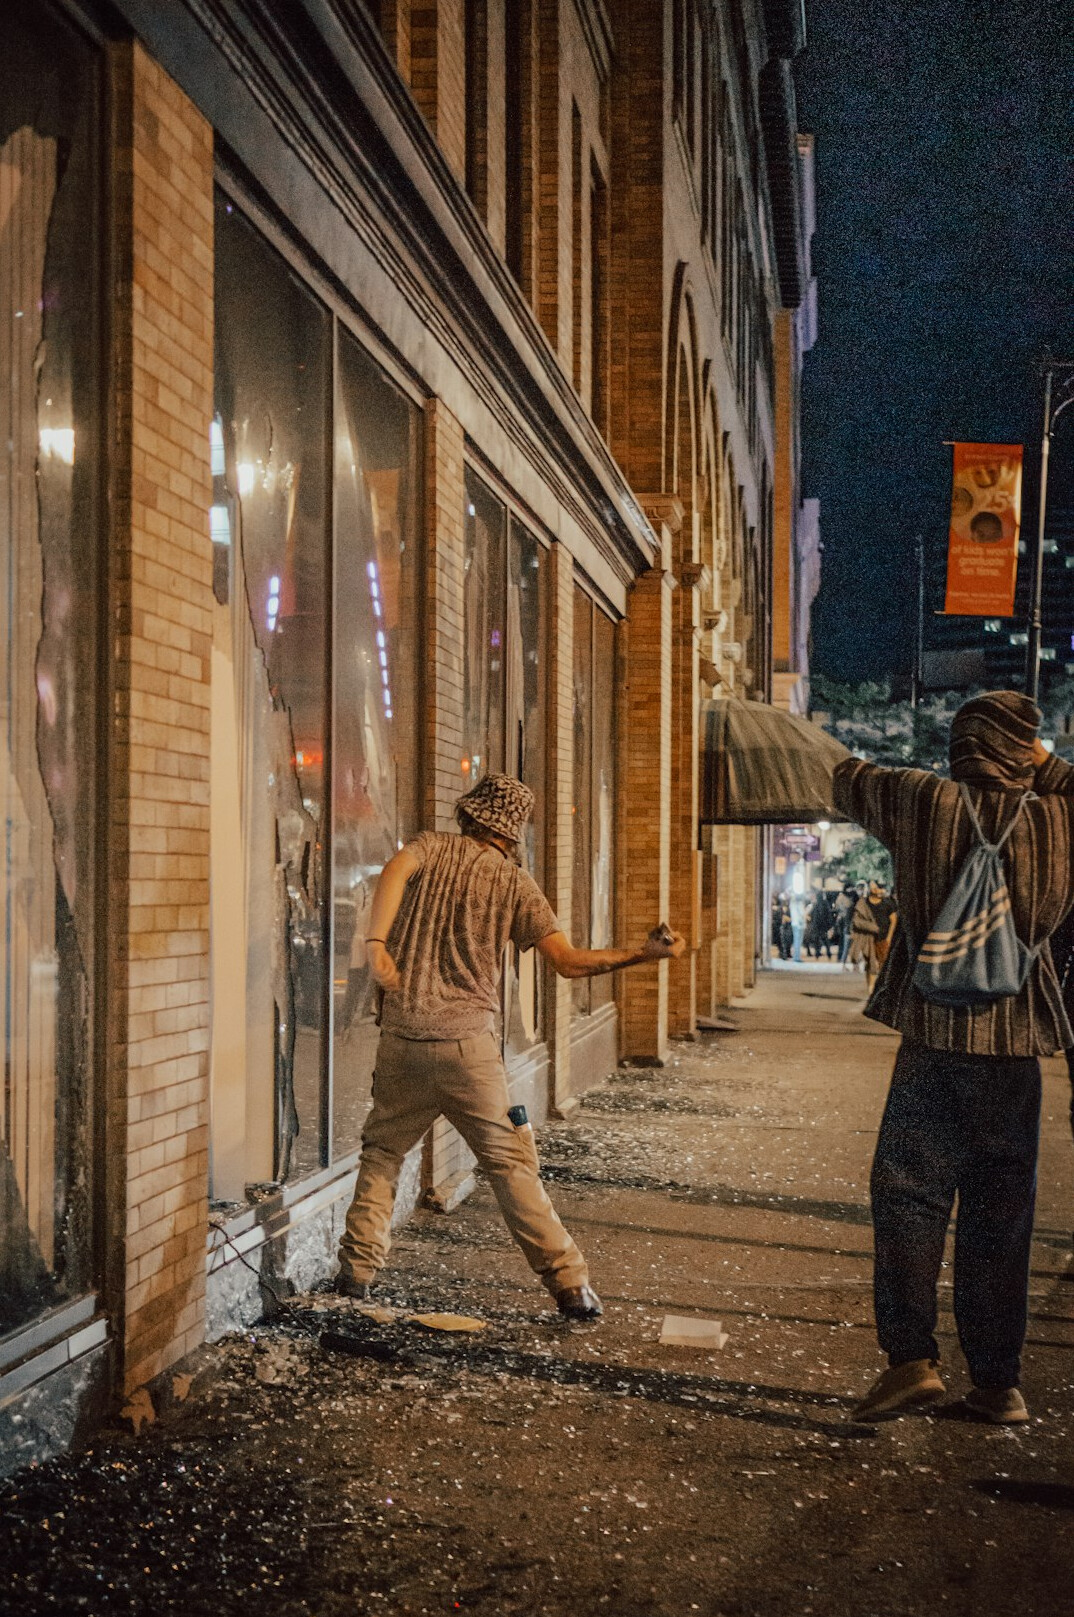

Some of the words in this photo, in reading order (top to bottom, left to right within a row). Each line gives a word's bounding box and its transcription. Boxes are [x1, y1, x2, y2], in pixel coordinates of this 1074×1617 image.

[951, 545, 961, 554] of
[958, 556, 1005, 567] graduate
[960, 567, 974, 575] on
